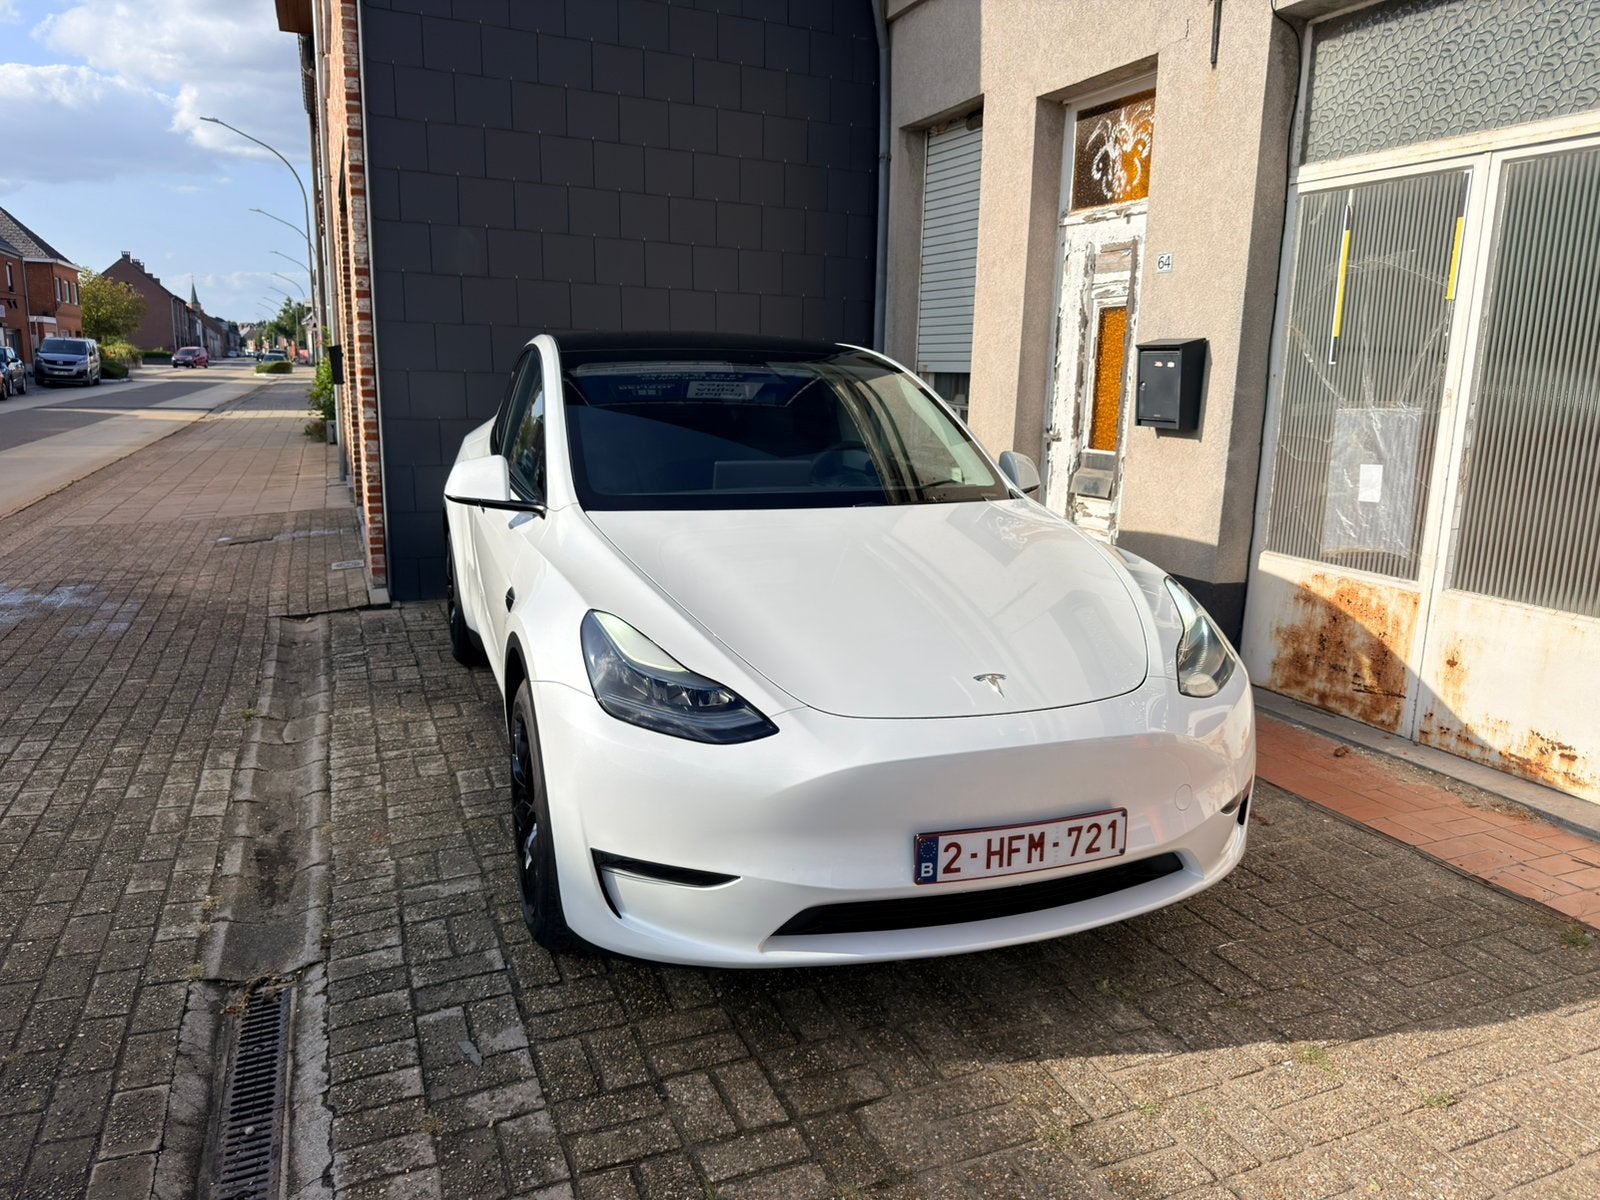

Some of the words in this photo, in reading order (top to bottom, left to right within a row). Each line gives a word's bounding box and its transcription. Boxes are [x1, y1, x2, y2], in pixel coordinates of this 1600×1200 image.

[1157, 255, 1171, 270] 64
[920, 862, 934, 878] B
[942, 819, 1118, 875] 2-HFM-721
